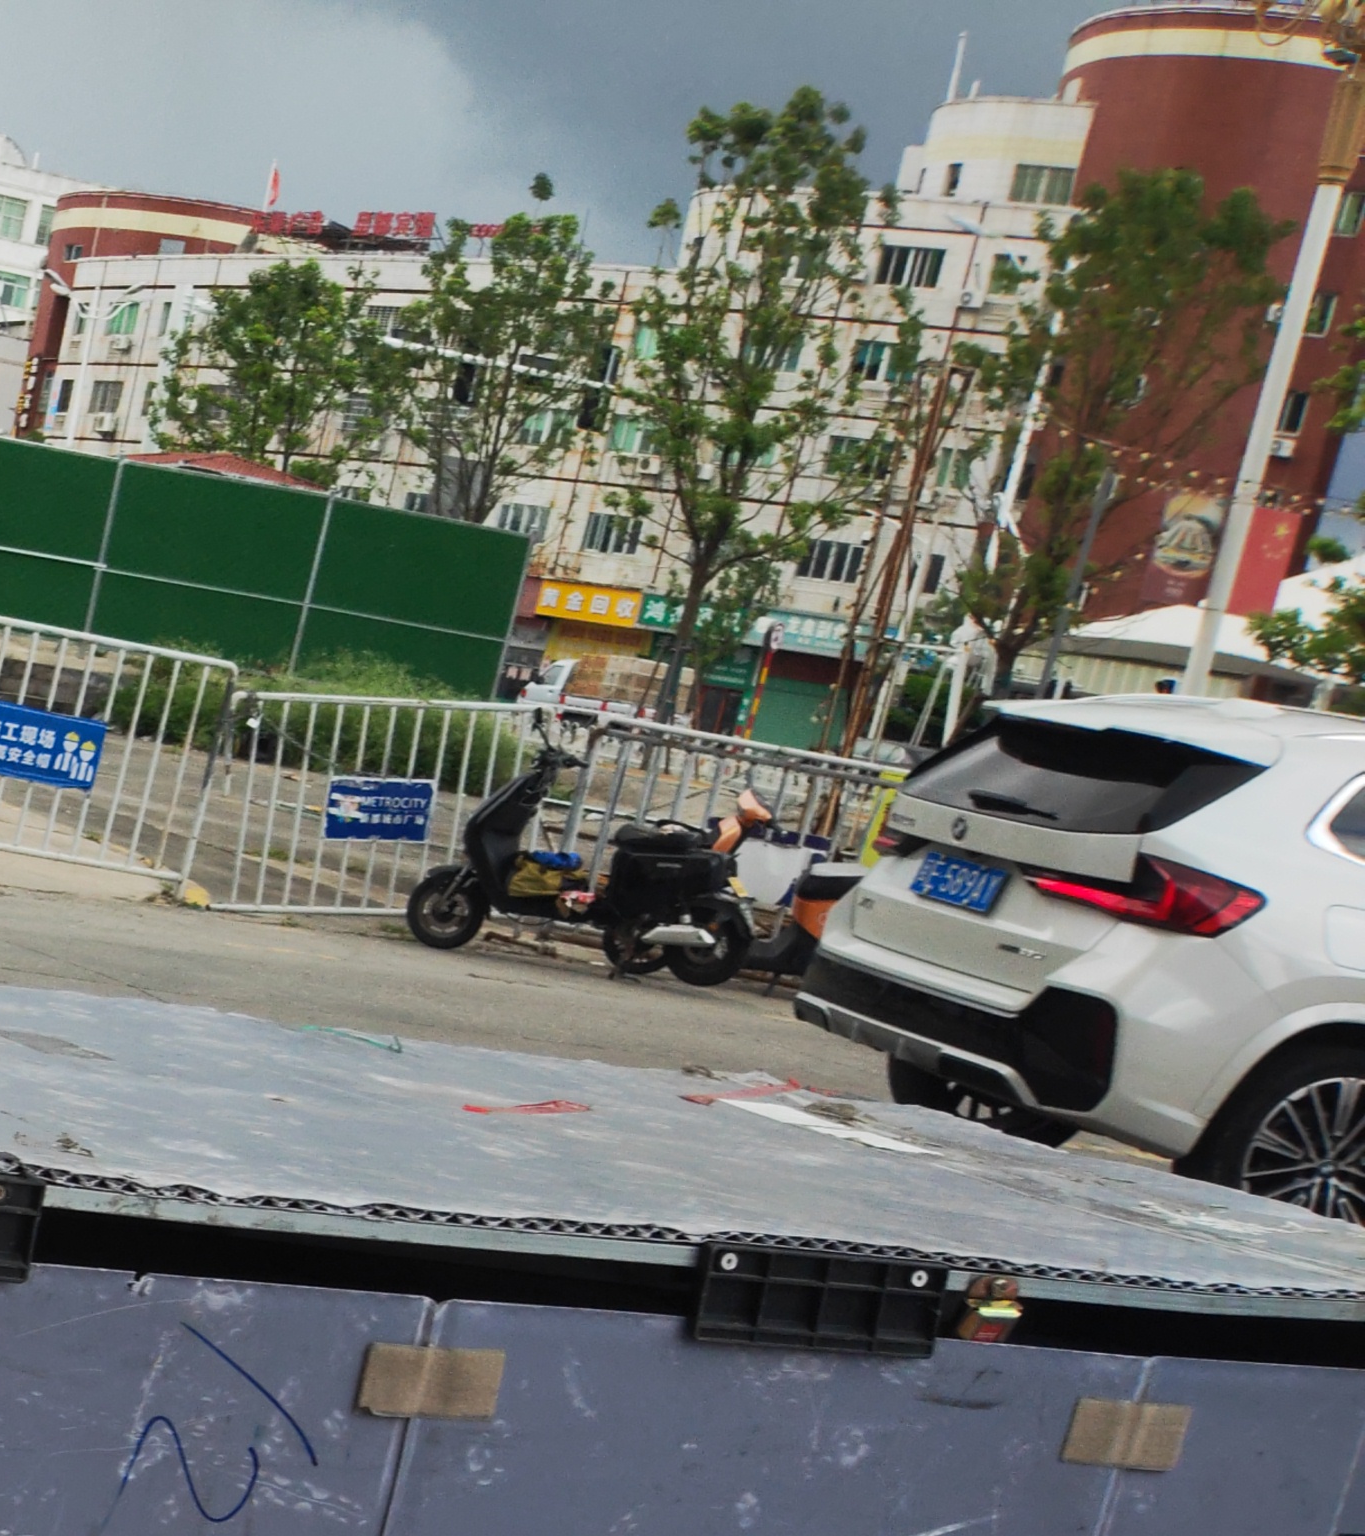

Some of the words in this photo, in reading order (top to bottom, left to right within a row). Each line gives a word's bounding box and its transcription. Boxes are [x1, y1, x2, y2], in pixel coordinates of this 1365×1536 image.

[539, 586, 636, 619] 黄金回收
[359, 795, 429, 809] METROCITY
